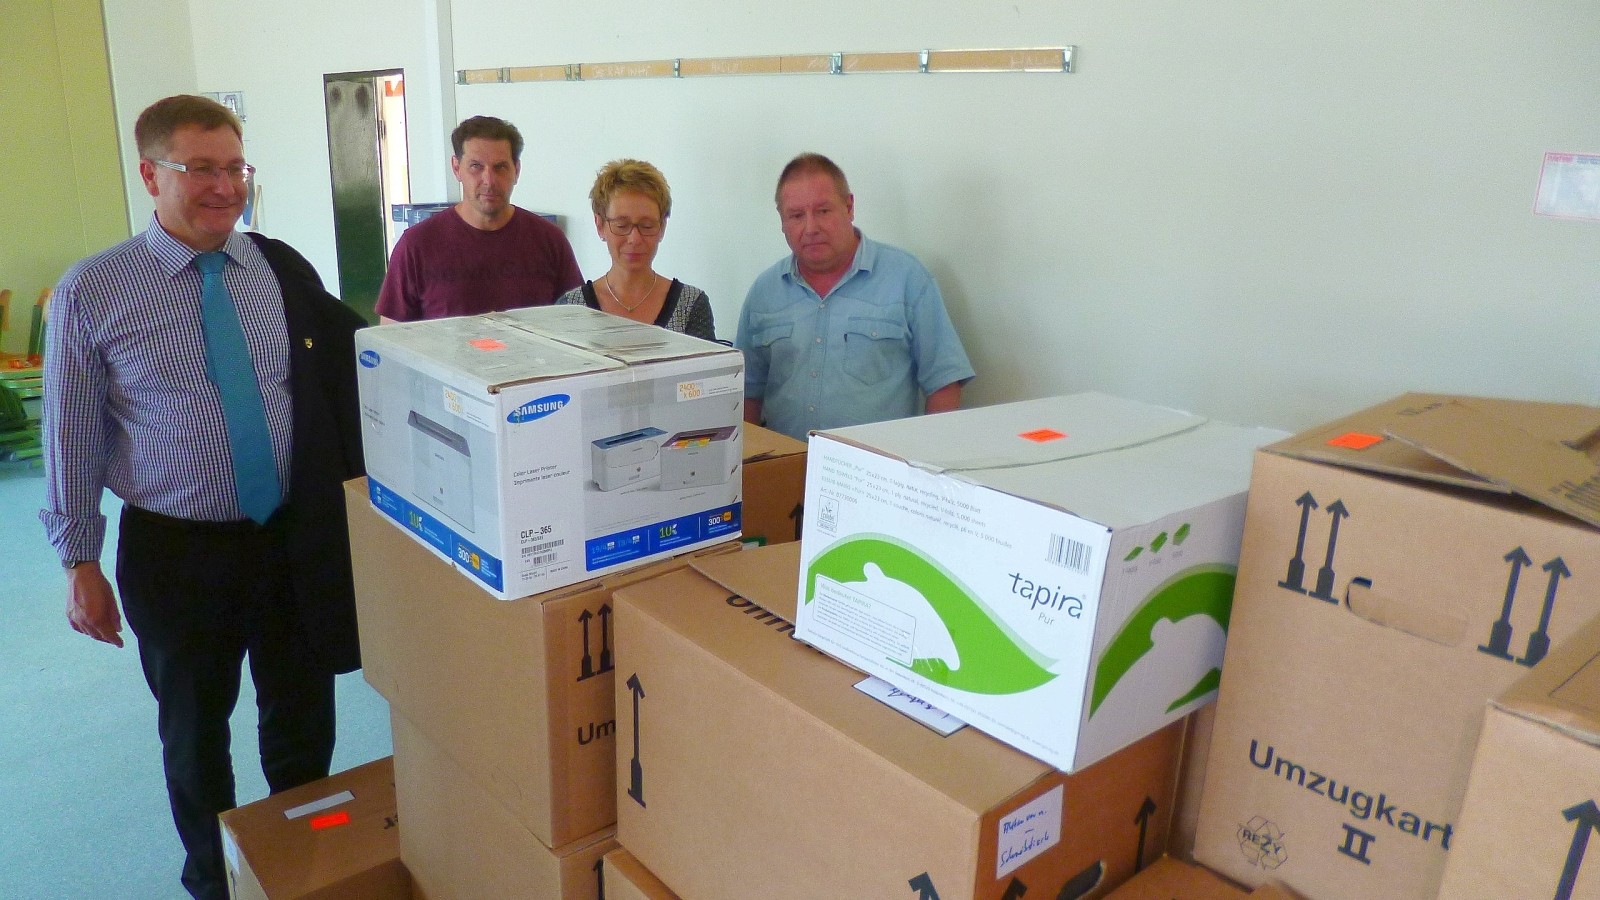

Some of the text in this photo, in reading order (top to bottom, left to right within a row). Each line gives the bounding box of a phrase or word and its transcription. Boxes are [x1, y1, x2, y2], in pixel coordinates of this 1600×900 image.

[513, 400, 565, 417] SAMSUNG
[1008, 572, 1083, 619] tapira
[1038, 612, 1055, 625] Pur
